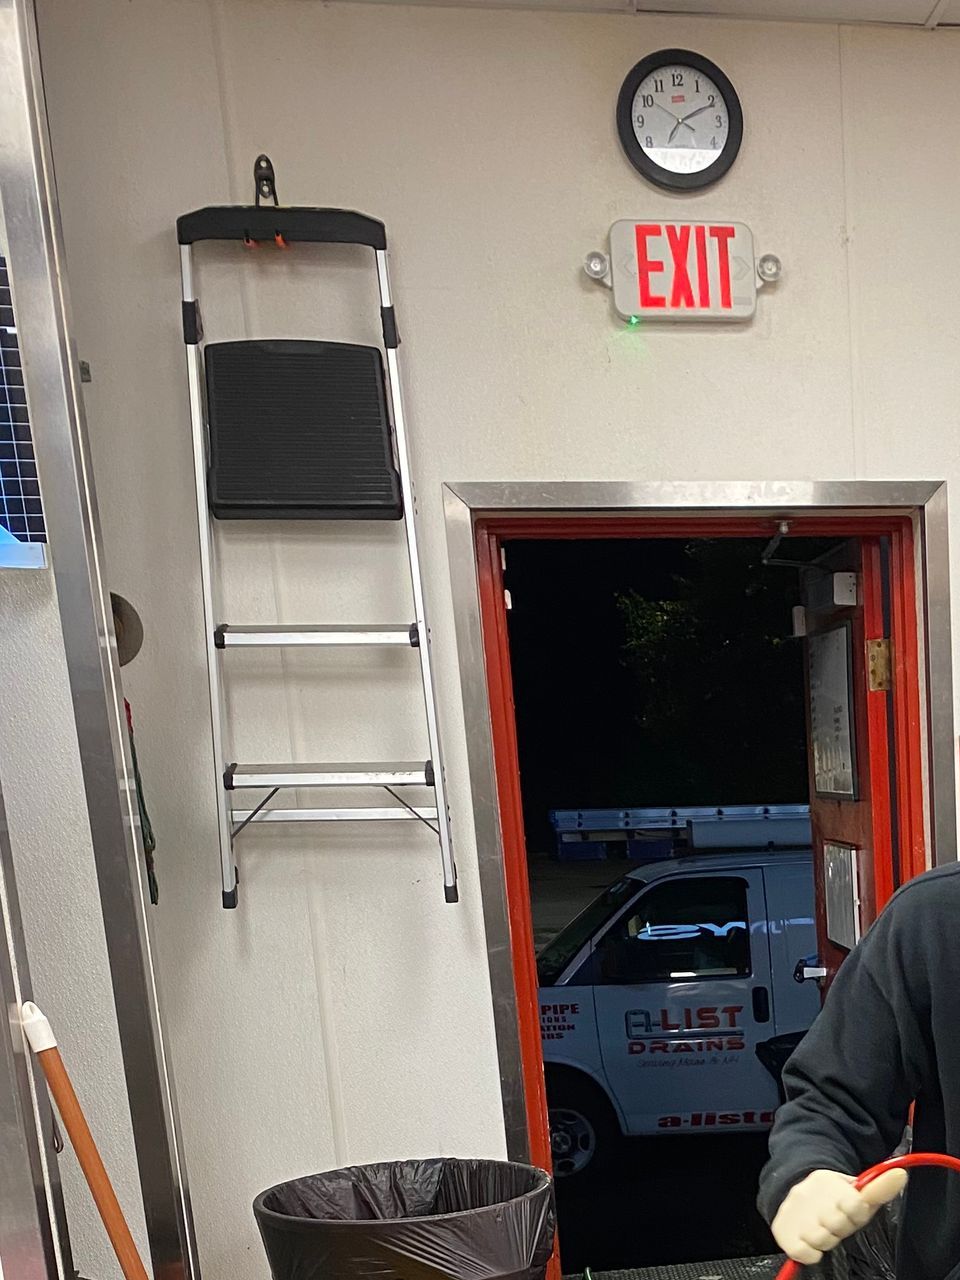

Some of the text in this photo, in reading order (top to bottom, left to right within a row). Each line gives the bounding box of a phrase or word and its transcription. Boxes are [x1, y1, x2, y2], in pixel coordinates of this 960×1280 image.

[654, 79, 665, 93] 11
[671, 73, 684, 86] 12
[694, 80, 700, 93] 1
[642, 94, 654, 108] 10
[707, 95, 715, 108] 2
[636, 114, 645, 128] 9
[715, 115, 722, 128] 3
[645, 136, 654, 148] 8
[710, 136, 718, 150] 4
[635, 224, 735, 309] EXIT
[541, 1003, 580, 1016] PIPE
[628, 1037, 745, 1055] DRAINS
